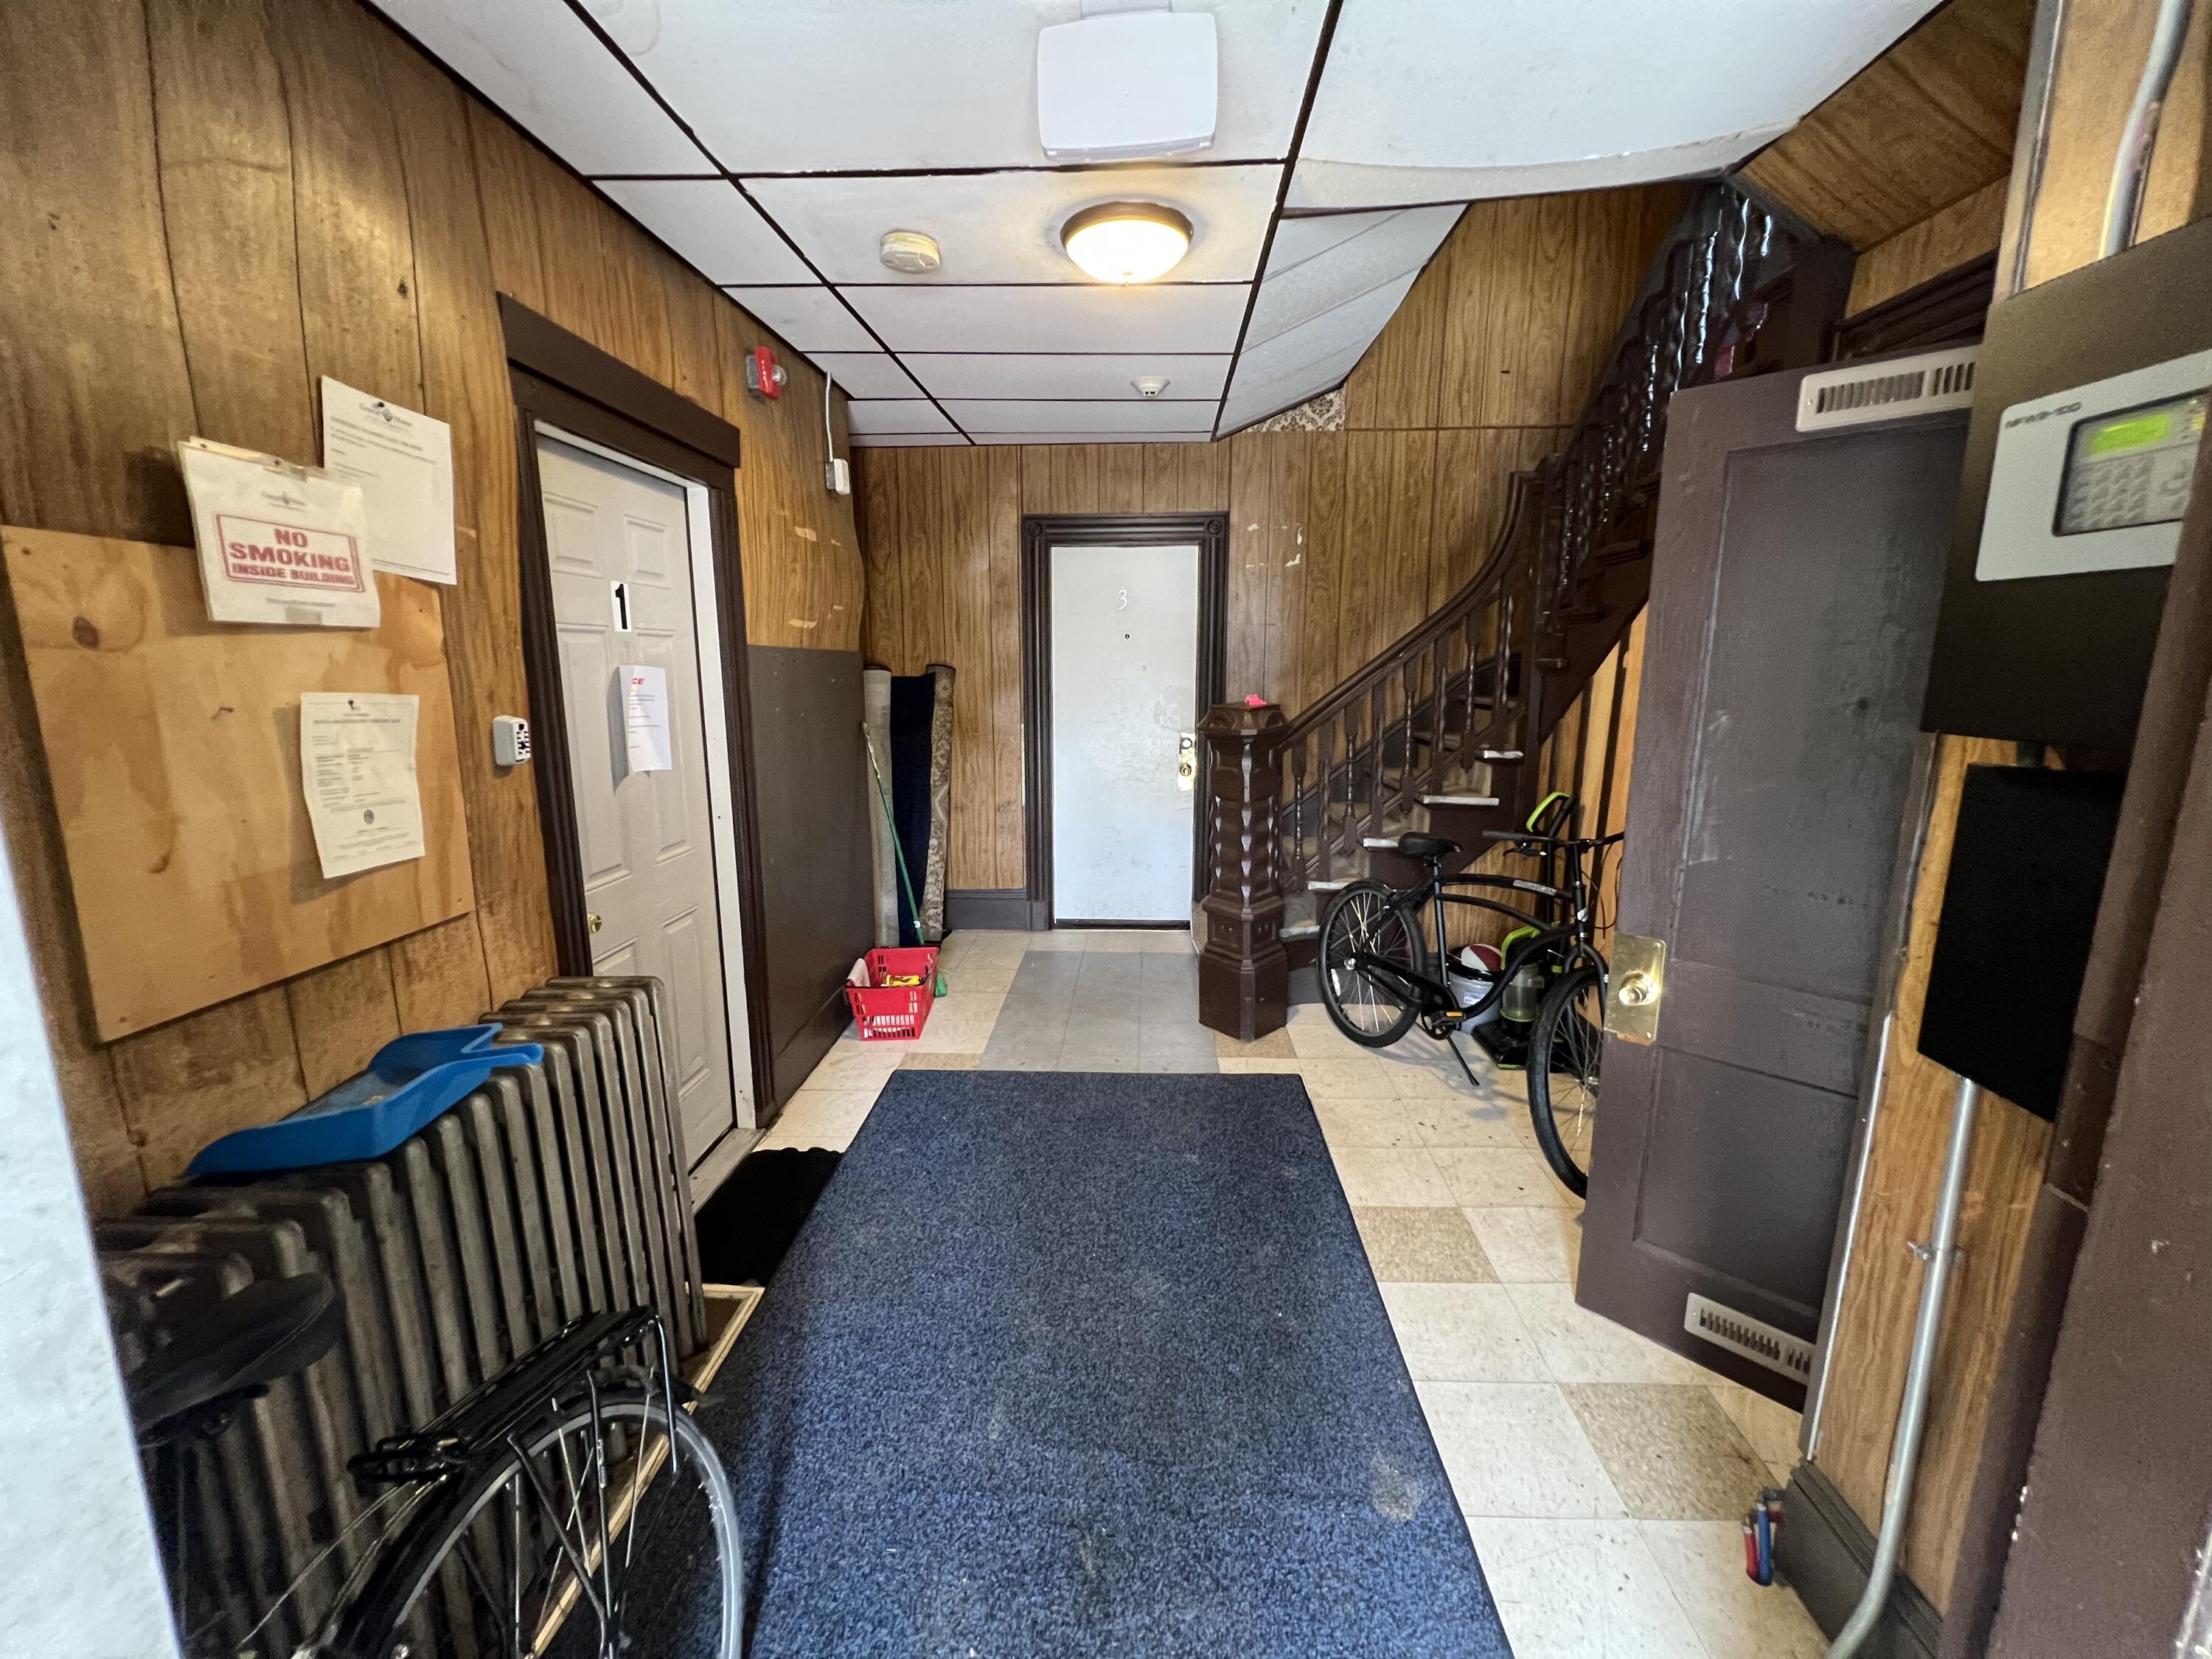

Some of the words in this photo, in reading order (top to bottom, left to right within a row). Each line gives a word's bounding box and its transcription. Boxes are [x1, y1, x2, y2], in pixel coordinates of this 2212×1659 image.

[274, 528, 307, 548] NO
[229, 542, 349, 571] SMOKING
[232, 563, 287, 578] INSIDE
[291, 569, 355, 585] BUILDING
[615, 583, 628, 630] 1
[1118, 588, 1127, 611] 3
